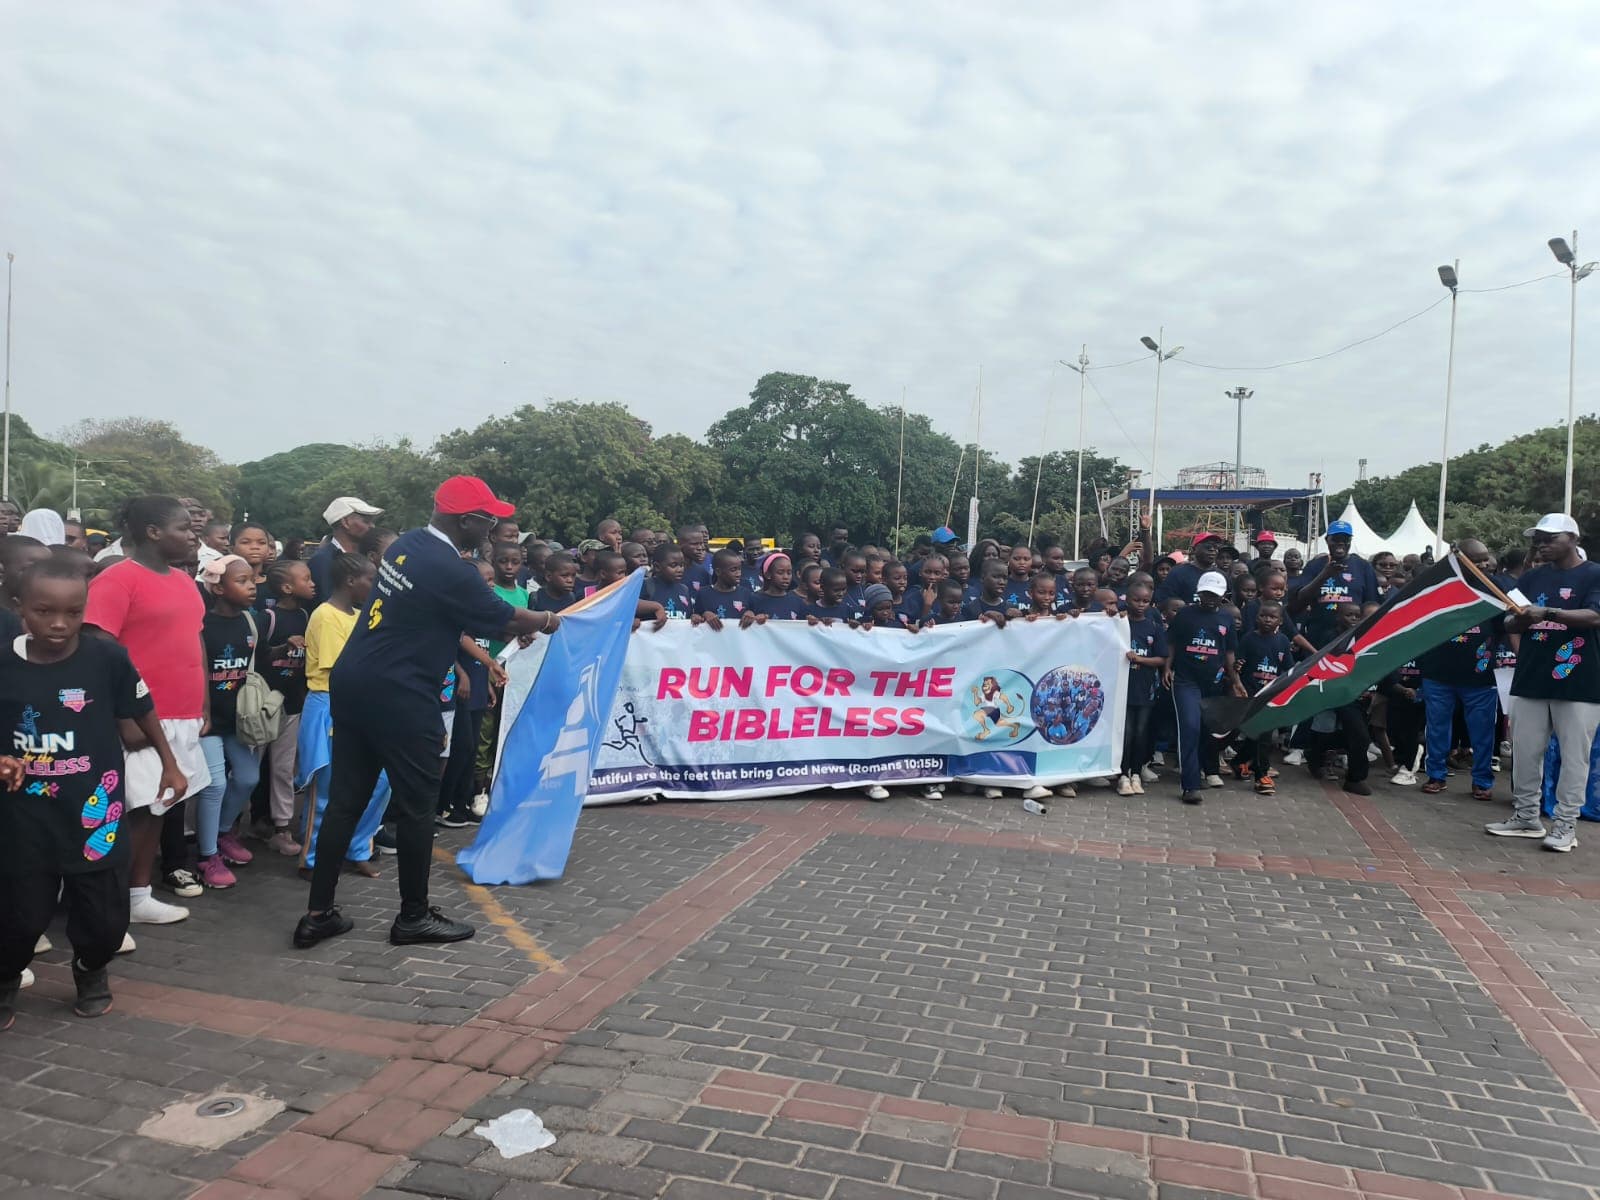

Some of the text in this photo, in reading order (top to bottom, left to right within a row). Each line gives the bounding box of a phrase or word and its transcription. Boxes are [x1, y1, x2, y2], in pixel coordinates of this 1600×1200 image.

[1320, 586, 1349, 595] RUN
[1192, 638, 1216, 647] RUN
[213, 656, 248, 670] RUN
[1257, 664, 1278, 673] RUN
[656, 665, 956, 700] RUN FOR THE
[687, 706, 926, 742] BIBLELESS
[13, 730, 75, 753] RUN
[25, 755, 92, 776] LELESS
[590, 757, 944, 786] autiful are the feet that bring Good News (Romans 10:15b)
